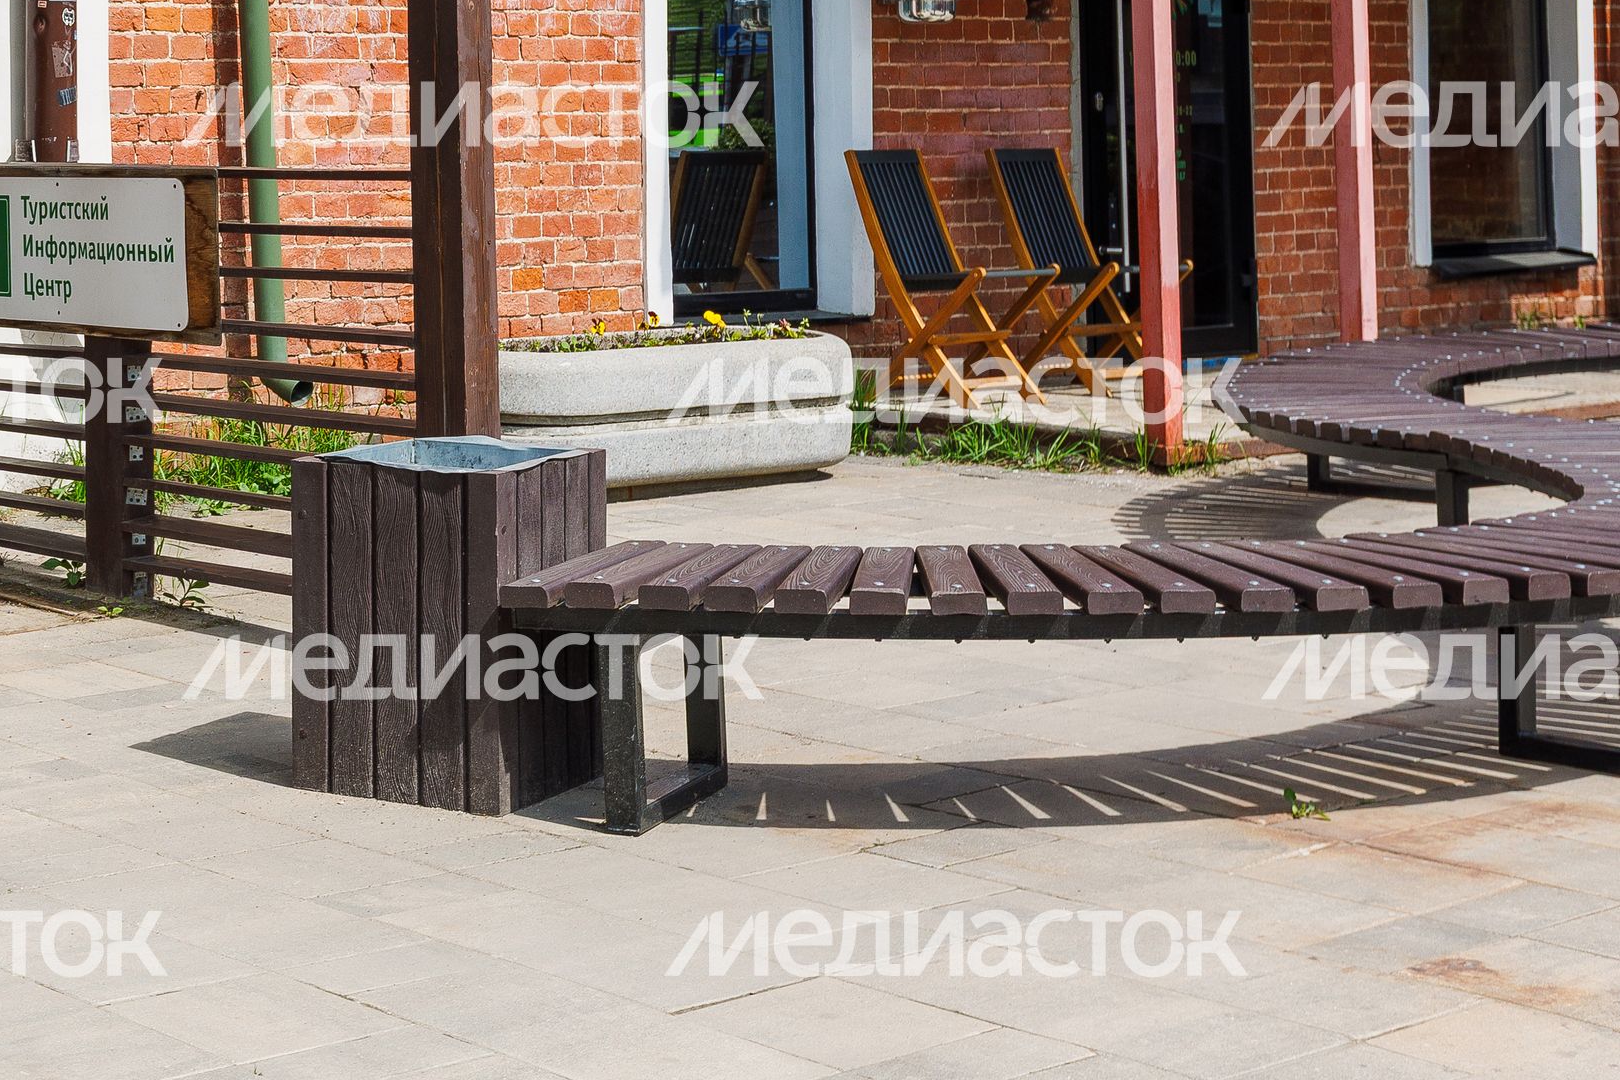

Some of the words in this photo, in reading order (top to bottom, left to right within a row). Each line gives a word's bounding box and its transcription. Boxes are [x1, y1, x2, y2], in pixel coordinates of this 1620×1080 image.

[21, 195, 109, 225] Туристский
[23, 234, 174, 265] Информационный
[23, 272, 72, 303] Центр
